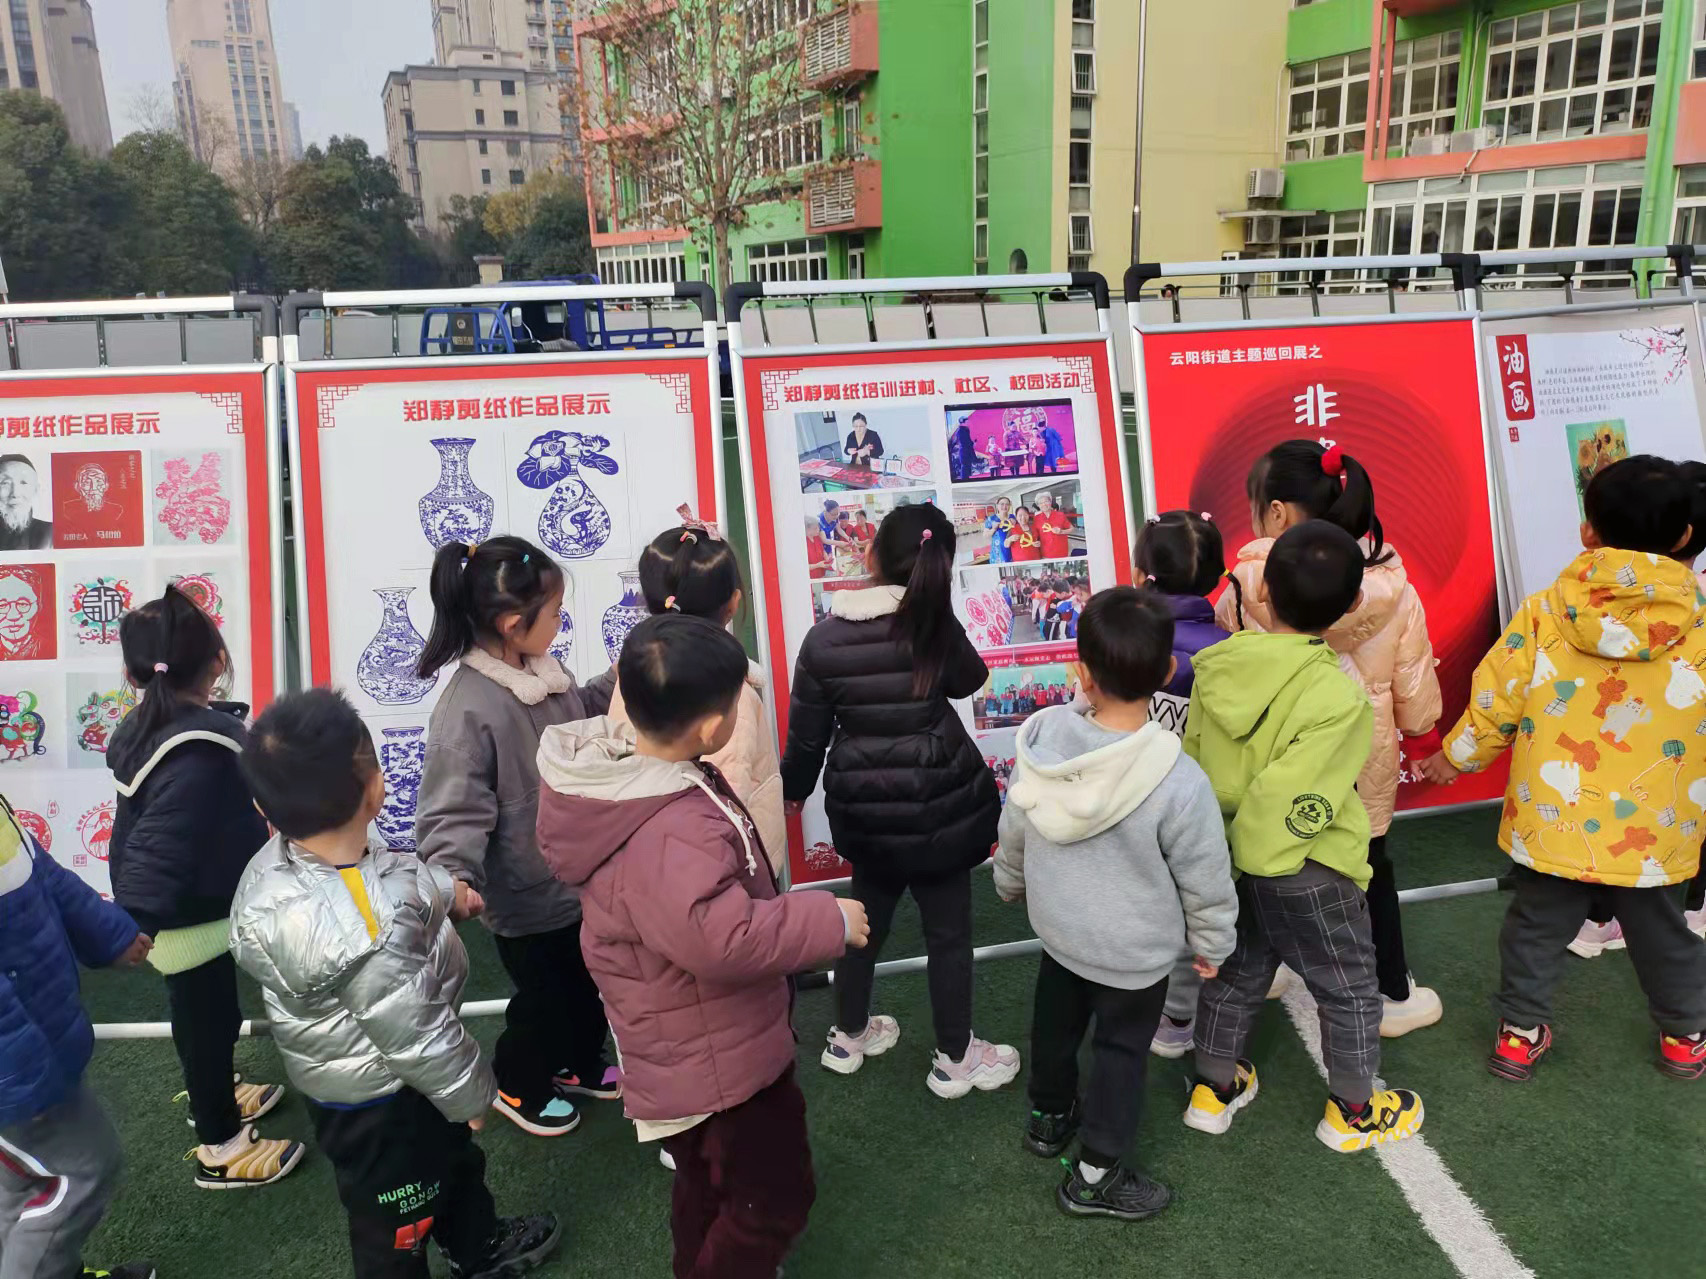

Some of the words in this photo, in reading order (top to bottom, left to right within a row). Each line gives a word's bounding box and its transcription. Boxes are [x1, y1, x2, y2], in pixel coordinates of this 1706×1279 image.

[1169, 344, 1323, 366] 云阳街道主题巡回展之
[1503, 341, 1530, 413] 油画
[403, 392, 611, 422] 郑静剪纸作品展示
[1294, 383, 1341, 450] 非
[0, 411, 161, 439] 剪纸作品展示
[378, 1181, 422, 1204] HURRY
